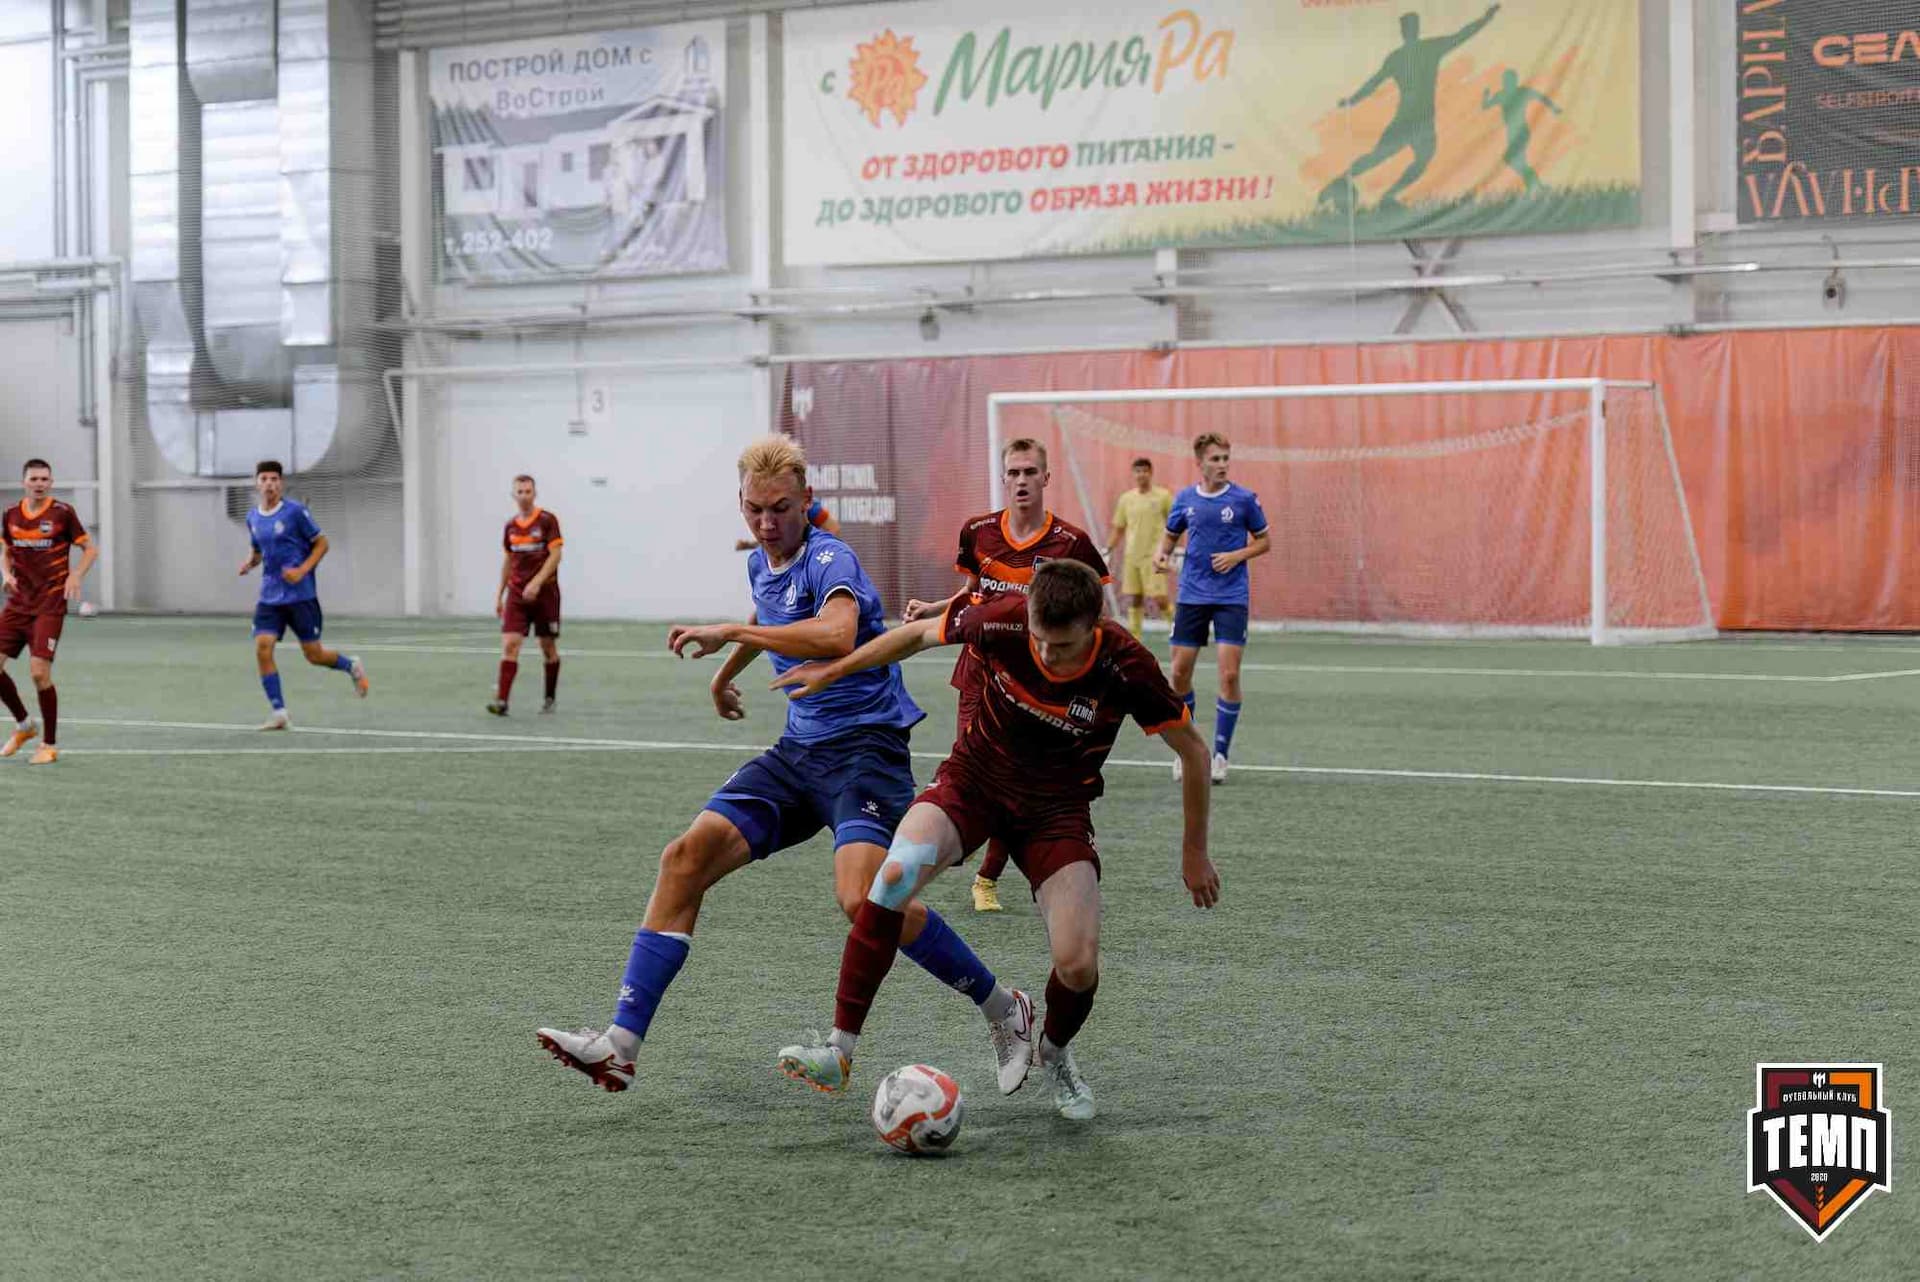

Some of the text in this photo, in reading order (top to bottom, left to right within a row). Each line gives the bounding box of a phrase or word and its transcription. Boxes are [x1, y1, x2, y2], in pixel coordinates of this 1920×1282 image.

[449, 50, 565, 83] ПОСТРОЙ
[573, 46, 632, 74] ДОМ
[861, 155, 897, 181] ОТ
[902, 144, 1070, 182] ЗДОРОВОГО
[815, 198, 856, 228] ДО
[860, 190, 1023, 226] ЗДОРОВОГО
[1029, 181, 1138, 213] ОБРАЗА
[592, 388, 605, 414] 3
